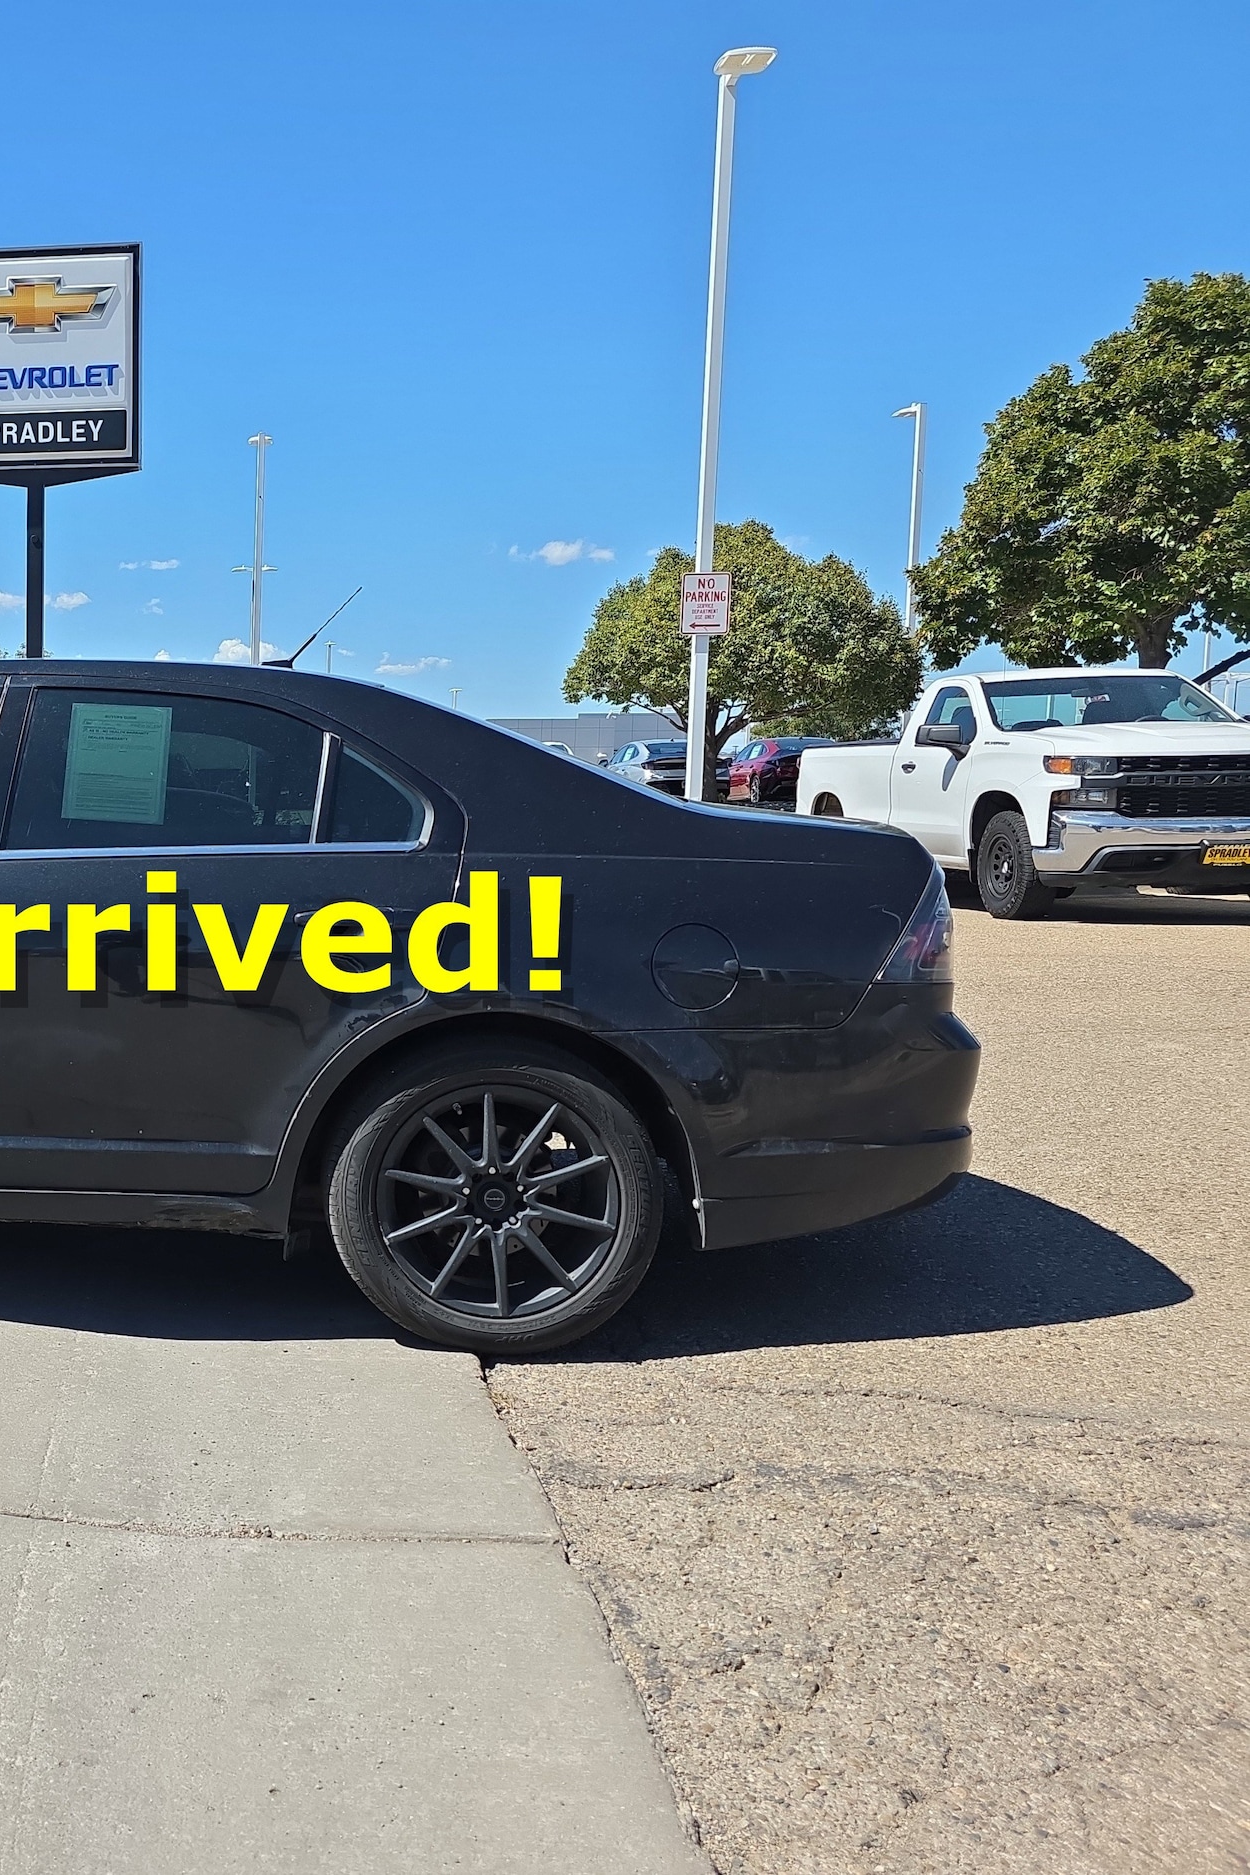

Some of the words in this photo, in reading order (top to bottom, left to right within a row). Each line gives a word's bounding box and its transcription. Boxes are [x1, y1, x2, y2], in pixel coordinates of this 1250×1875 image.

[697, 578, 716, 590] NO
[685, 591, 727, 602] PARKING
[1127, 774, 1250, 786] CHEVR
